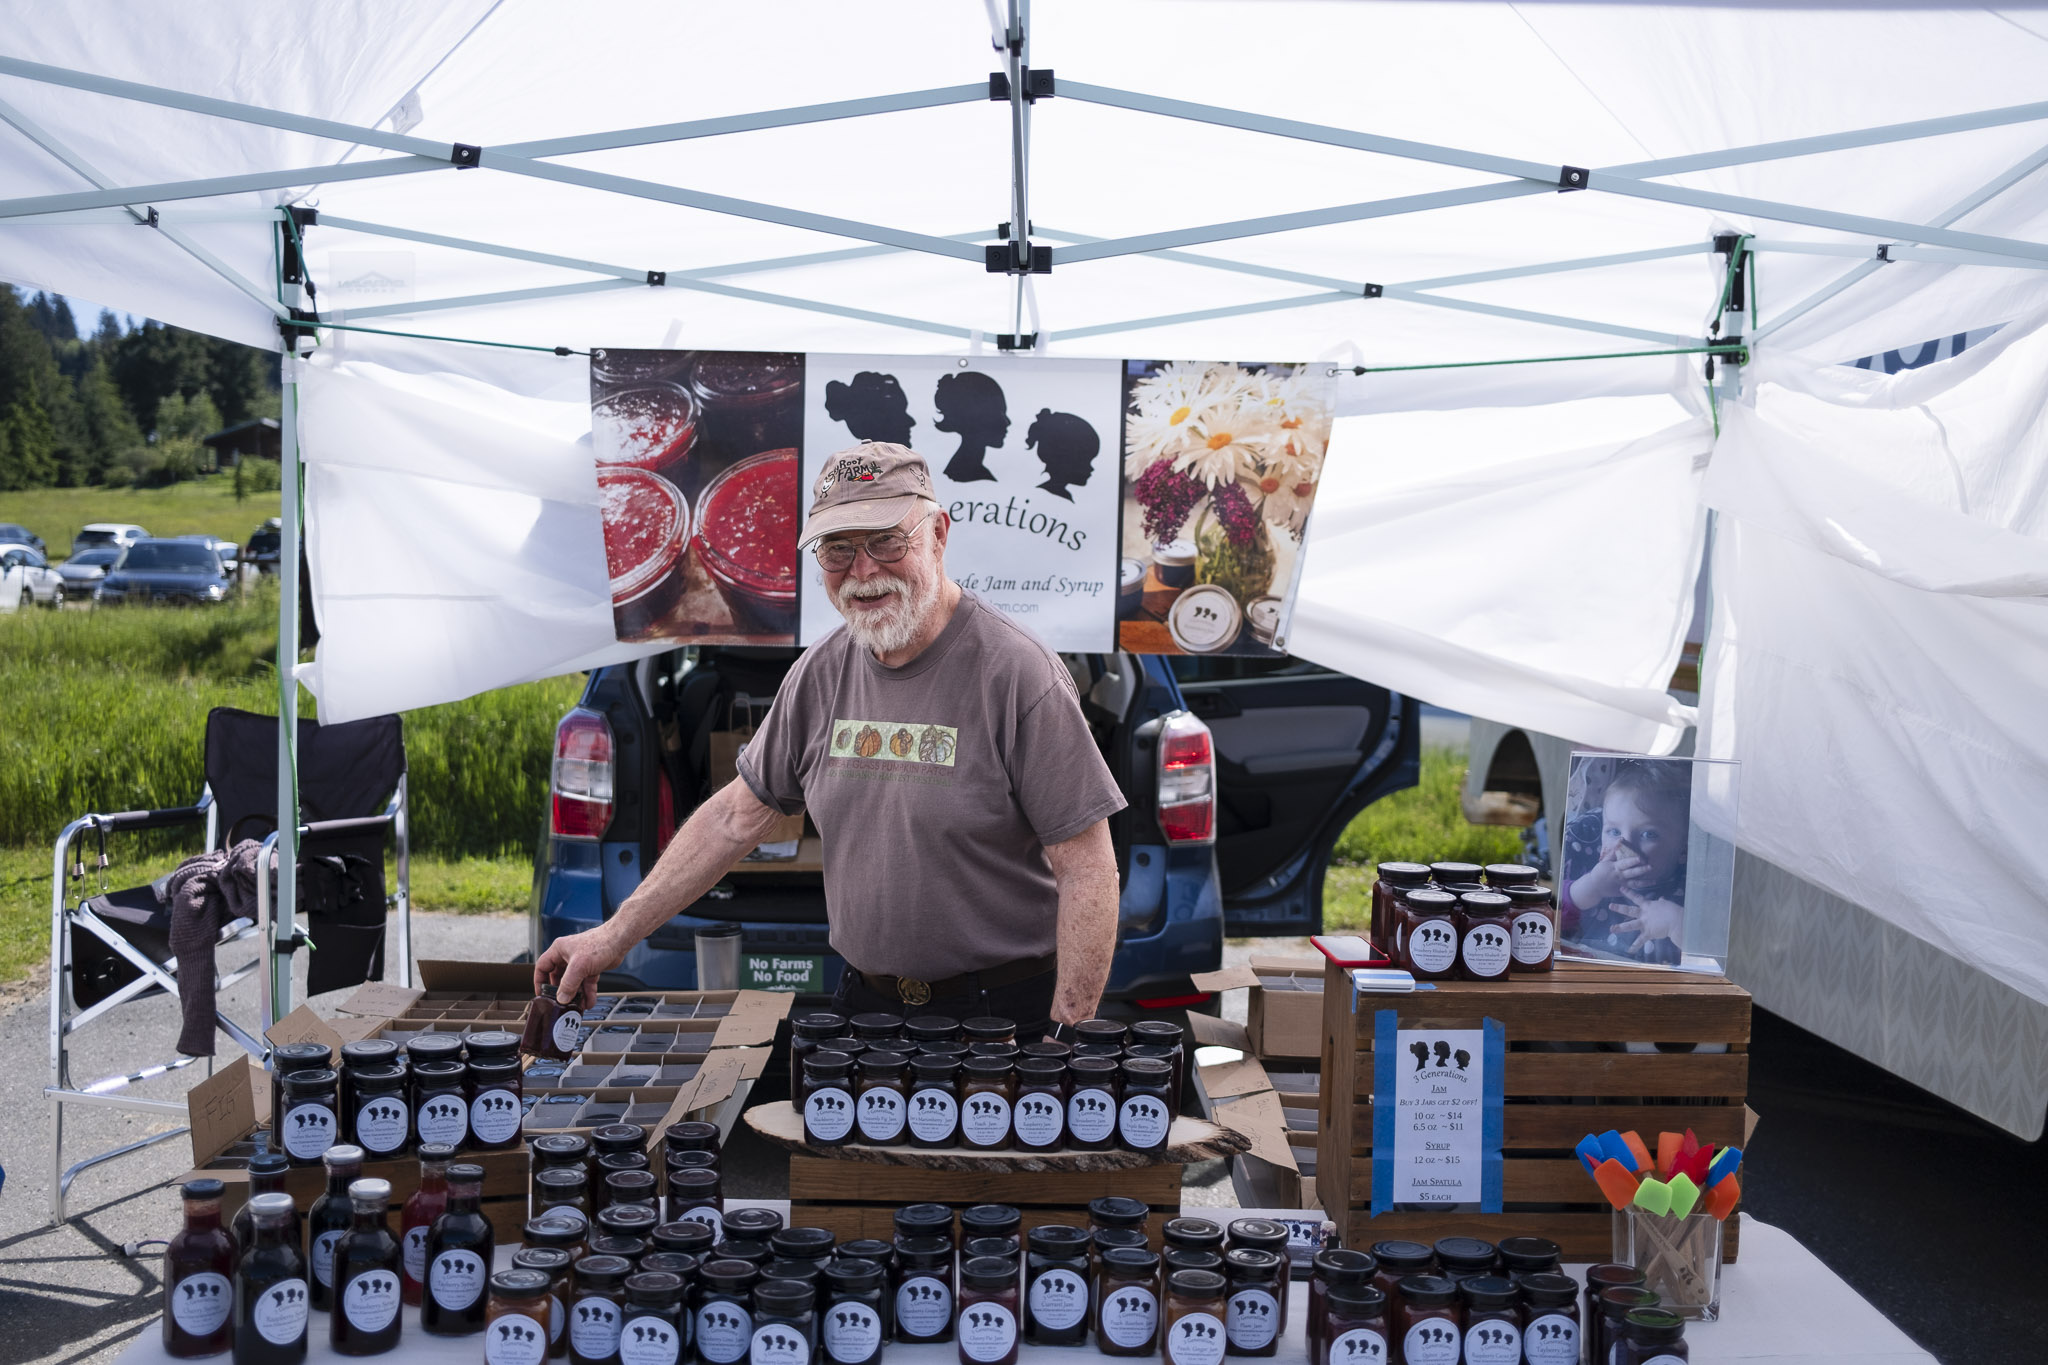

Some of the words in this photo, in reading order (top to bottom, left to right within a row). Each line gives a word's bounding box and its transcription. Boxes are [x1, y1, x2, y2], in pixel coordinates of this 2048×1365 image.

[837, 464, 871, 482] FARM
[949, 496, 1087, 551] erations
[982, 575, 1016, 592] Jam
[1021, 575, 1056, 591] and
[1055, 577, 1104, 597] Syrup
[852, 760, 880, 770] GLASS
[881, 762, 919, 773] PUMPKIN
[921, 766, 954, 777] PATCH
[749, 958, 768, 970] No
[772, 958, 813, 970] Farms
[753, 970, 772, 982] No
[776, 970, 810, 982] Food
[1413, 1075, 1420, 1084] 3
[1421, 1070, 1469, 1083] Generations
[1414, 1112, 1424, 1120] 10
[1447, 1111, 1463, 1120] $14
[1413, 1123, 1426, 1131] 6.5
[1449, 1123, 1464, 1131] $11
[1445, 1155, 1461, 1164] $15
[1419, 1192, 1430, 1201] $5
